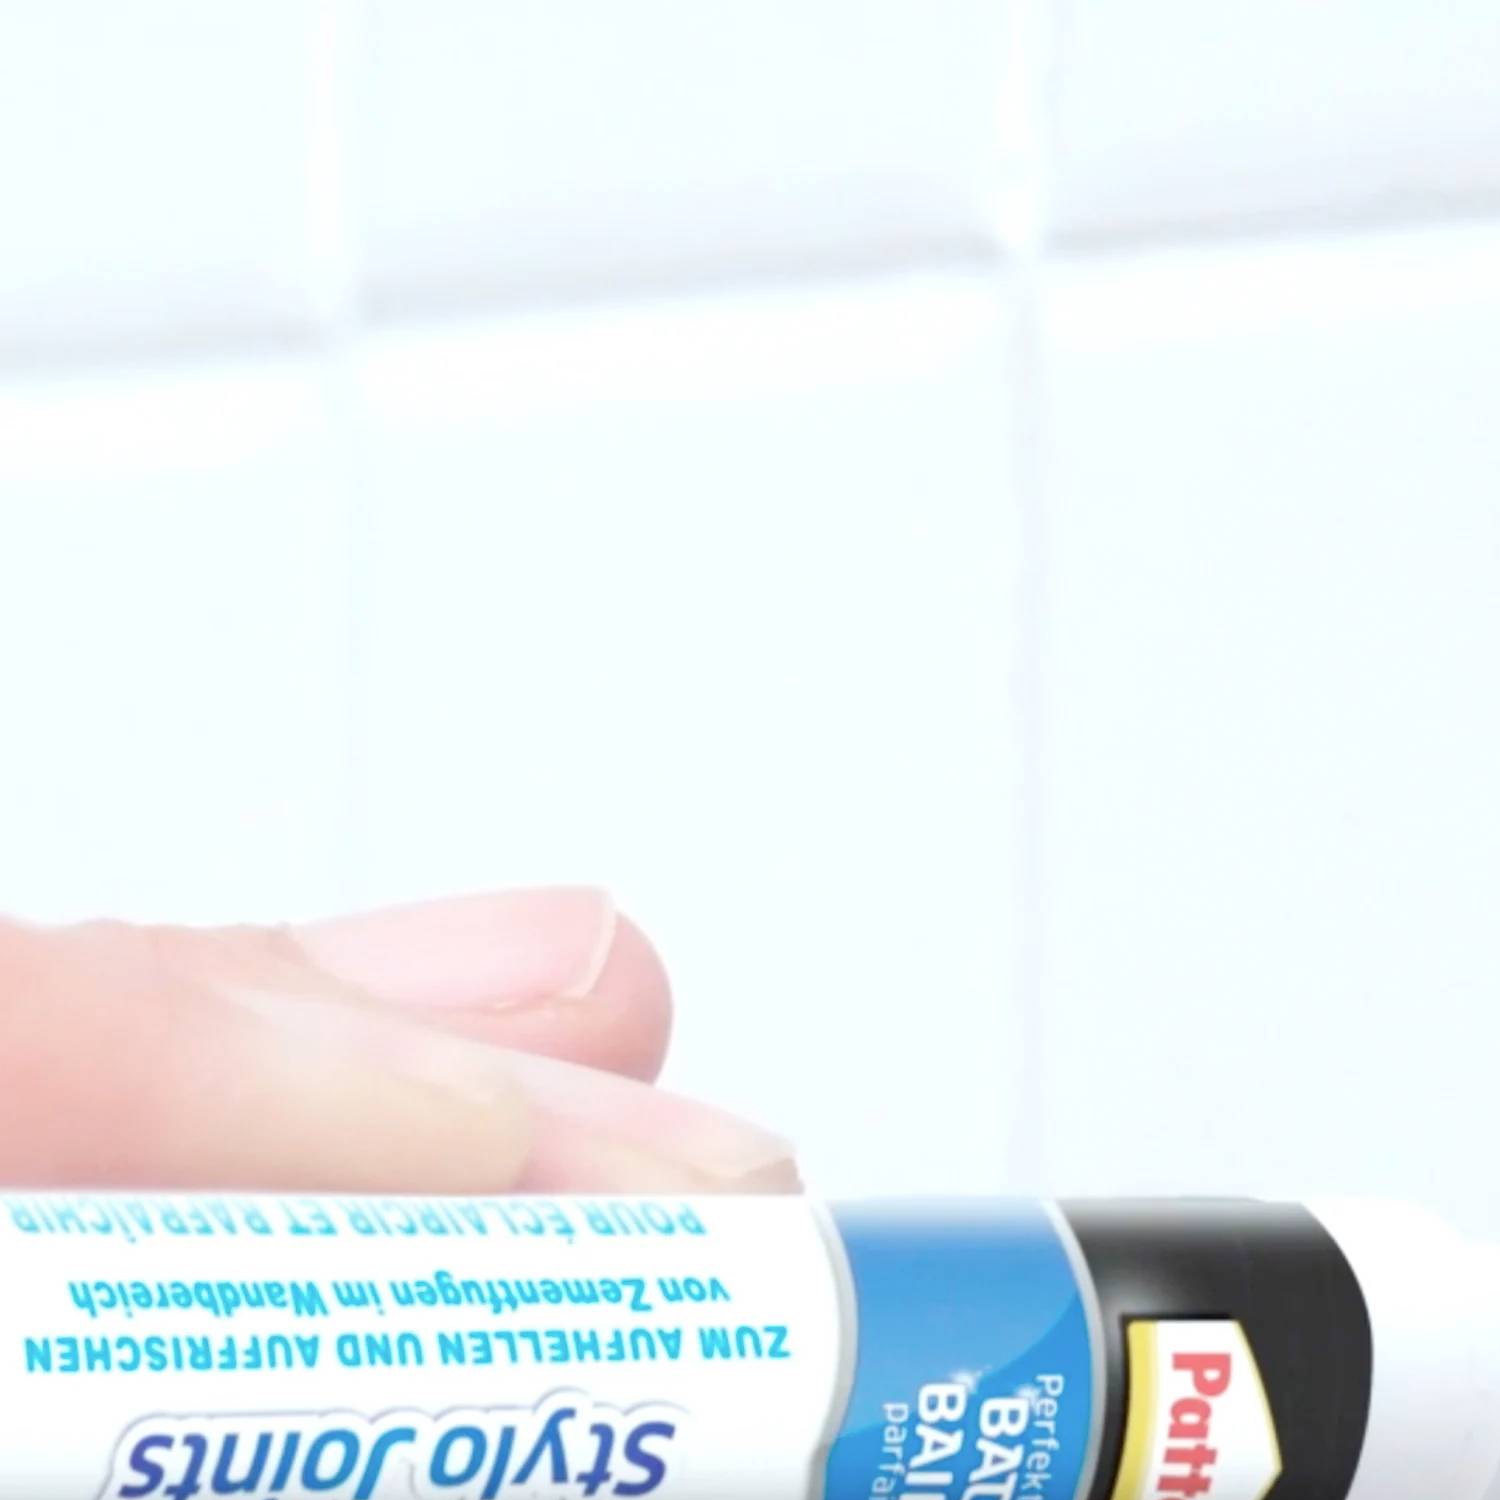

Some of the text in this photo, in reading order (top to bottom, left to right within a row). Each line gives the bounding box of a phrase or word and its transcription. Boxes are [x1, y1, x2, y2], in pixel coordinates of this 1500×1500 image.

[280, 1200, 338, 1235] ET
[584, 1200, 707, 1236] POUR
[68, 1270, 731, 1317] von Zementfugen im Wandbereich
[24, 1325, 791, 1373] ZUM AUFHELLEN UND AUFFRISCHEN
